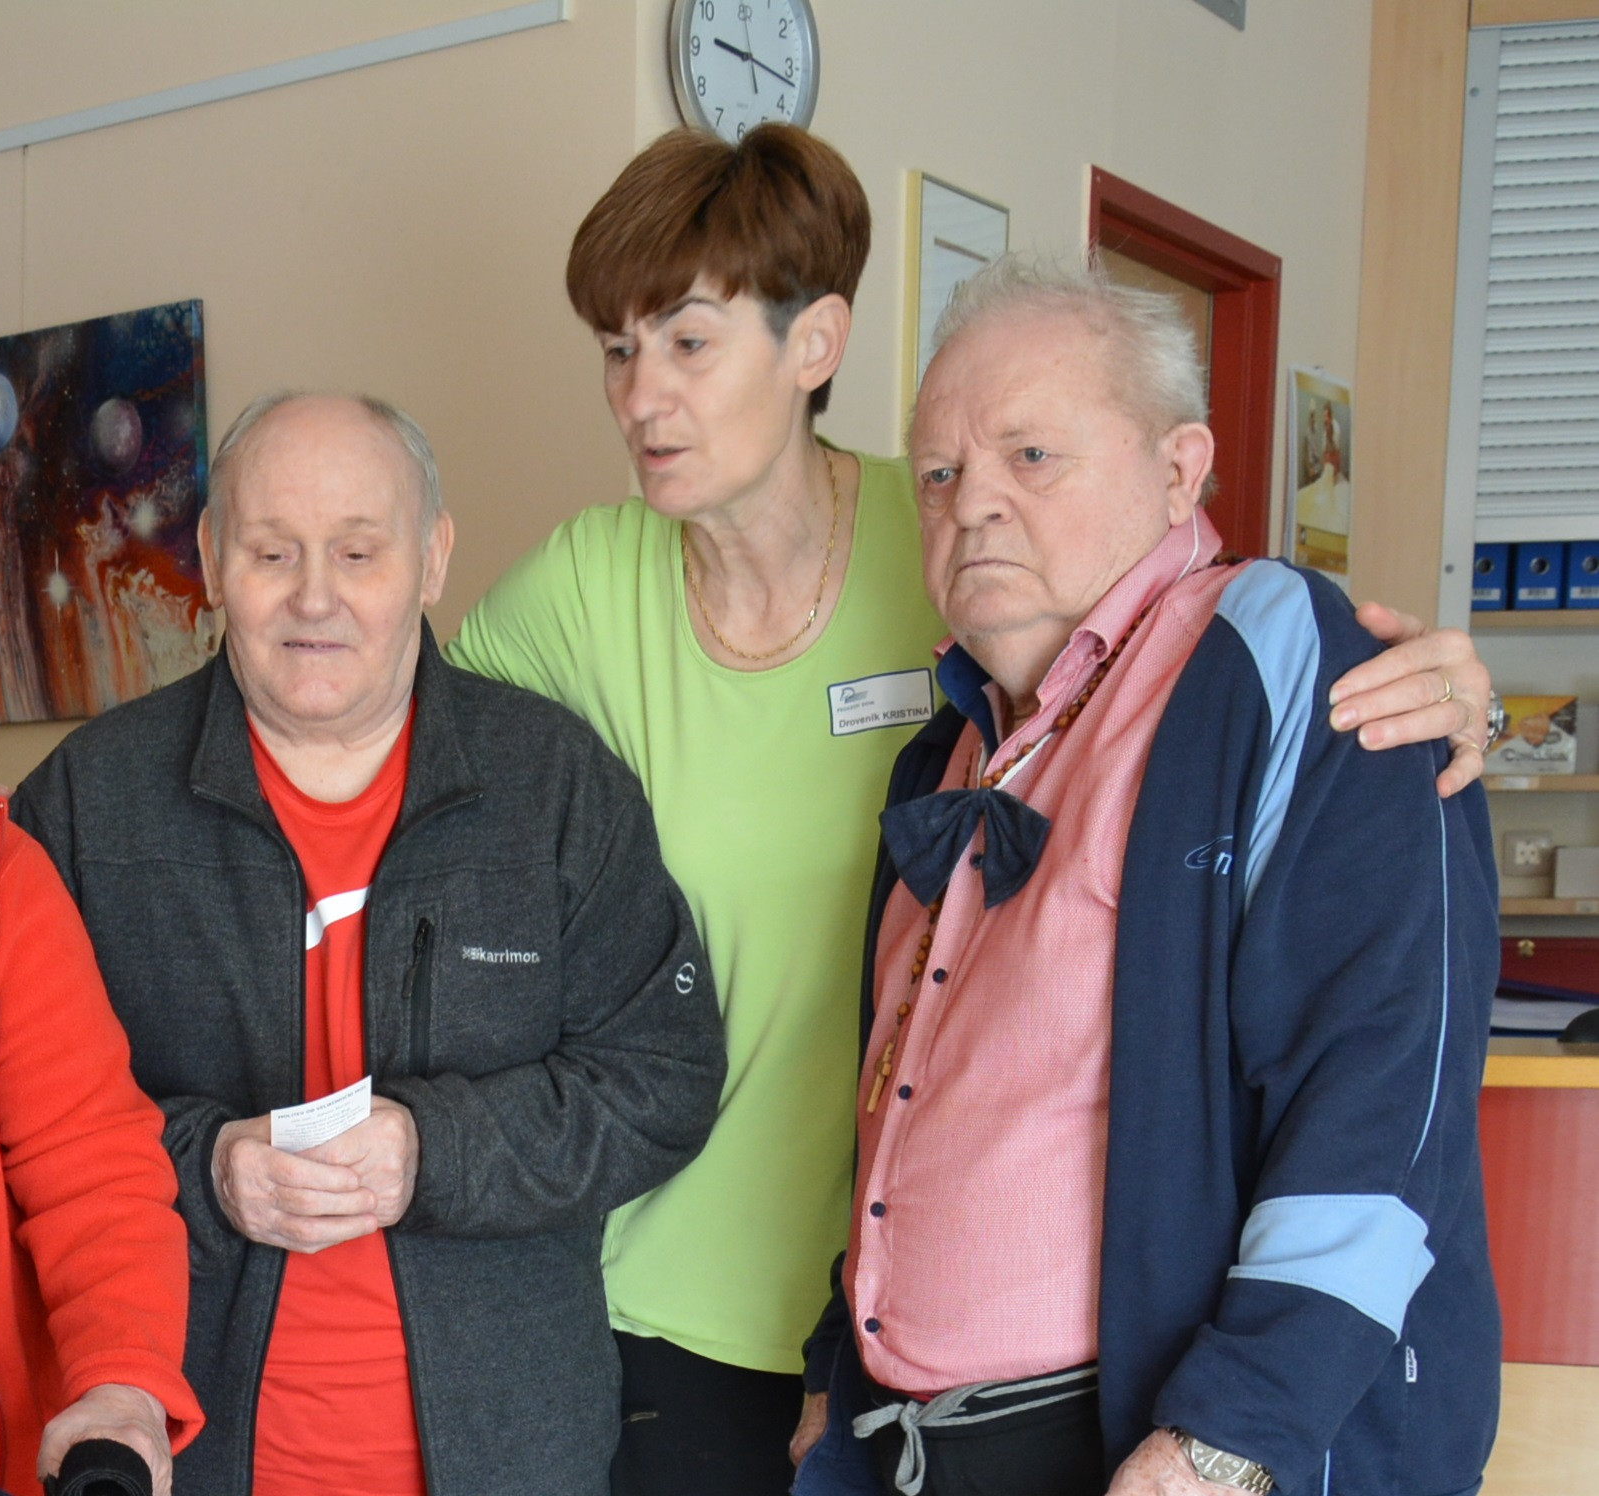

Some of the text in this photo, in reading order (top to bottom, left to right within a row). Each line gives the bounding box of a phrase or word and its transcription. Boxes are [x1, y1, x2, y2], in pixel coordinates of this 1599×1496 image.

[699, 0, 715, 21] 10
[778, 18, 788, 39] 2
[691, 35, 701, 56] 9
[784, 57, 794, 78] 3
[697, 75, 706, 97] 8
[776, 93, 785, 113] 4
[715, 107, 724, 127] 7
[882, 706, 930, 720] KRISTINA
[480, 947, 538, 964] karrimor
